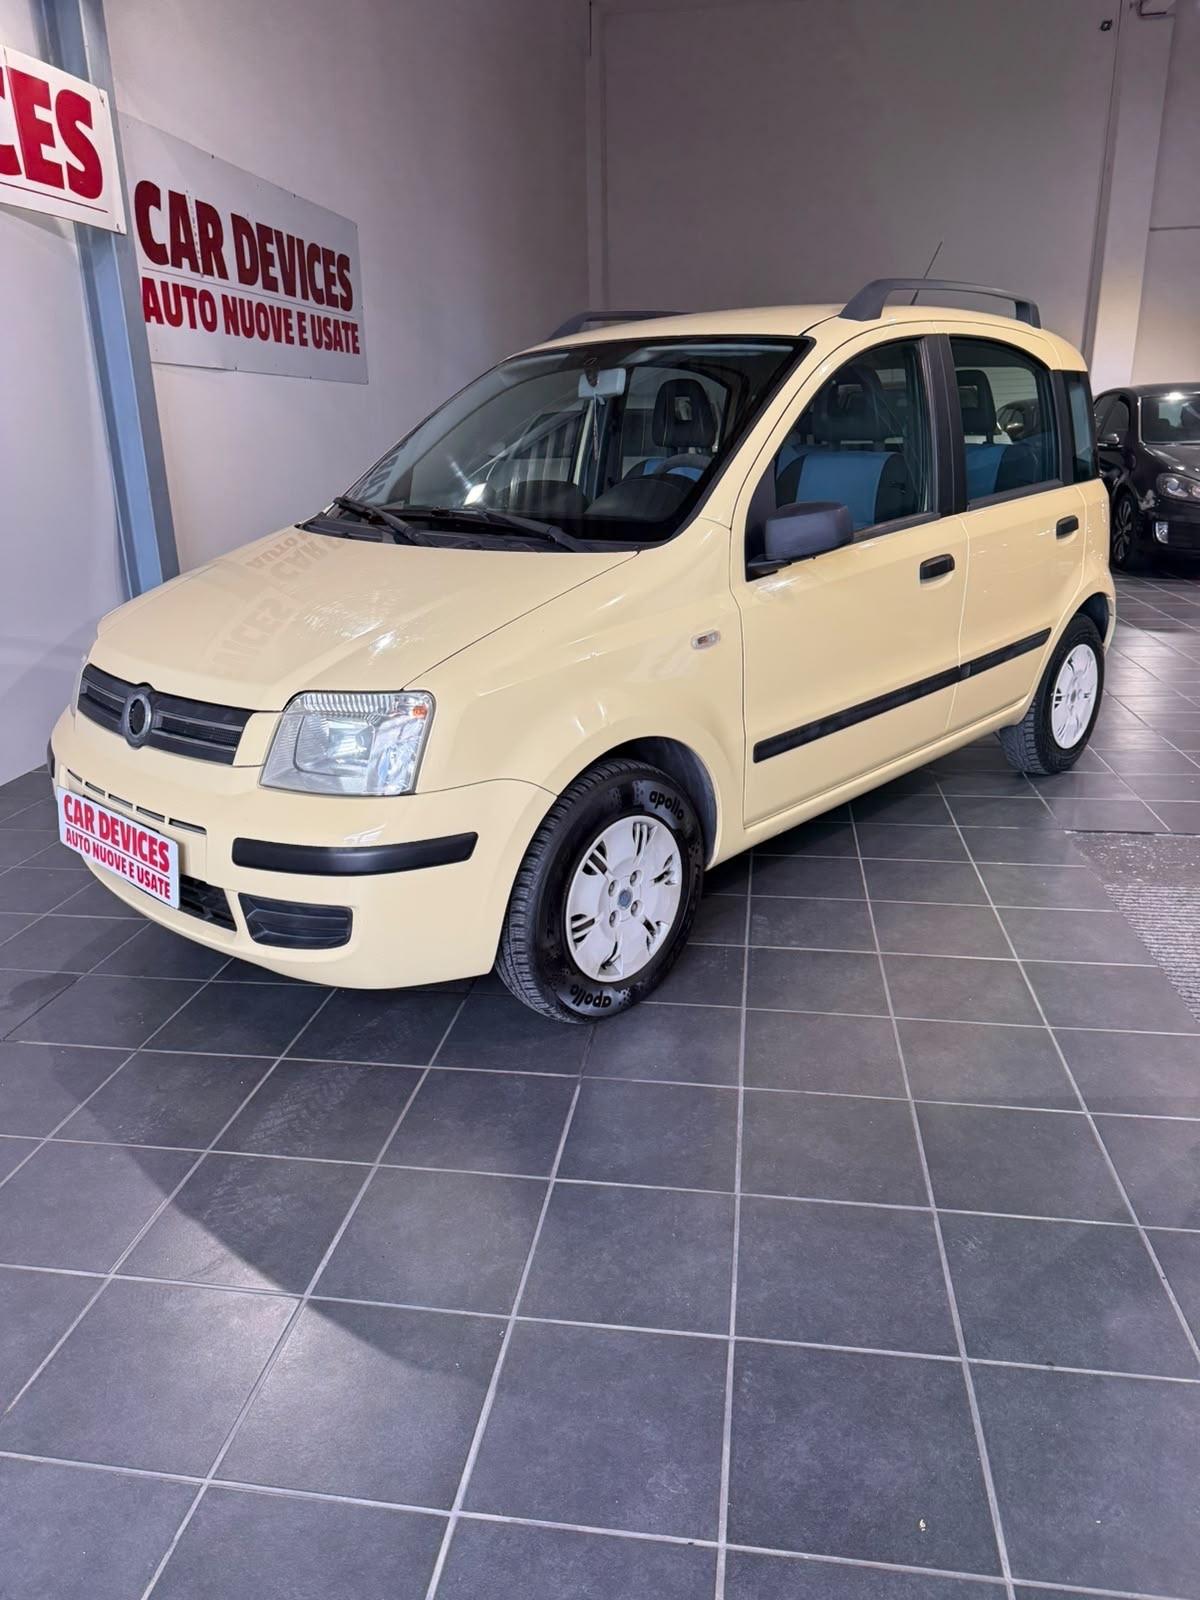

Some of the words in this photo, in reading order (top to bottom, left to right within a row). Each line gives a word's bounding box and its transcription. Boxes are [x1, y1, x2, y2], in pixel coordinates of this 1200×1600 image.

[134, 180, 229, 281] CAR
[230, 212, 353, 312] DEVICES
[141, 276, 218, 333] AUTO
[221, 293, 295, 346] NUOVE
[296, 311, 308, 347] E
[310, 314, 360, 355] USATE
[63, 794, 95, 835] CAR
[98, 809, 170, 873] DEVICES
[649, 790, 684, 820] apollo
[66, 827, 91, 854] AUTO
[92, 841, 127, 875] NUOVE
[129, 861, 135, 879] E
[136, 865, 171, 900] USATE
[570, 984, 612, 1008] apollo
